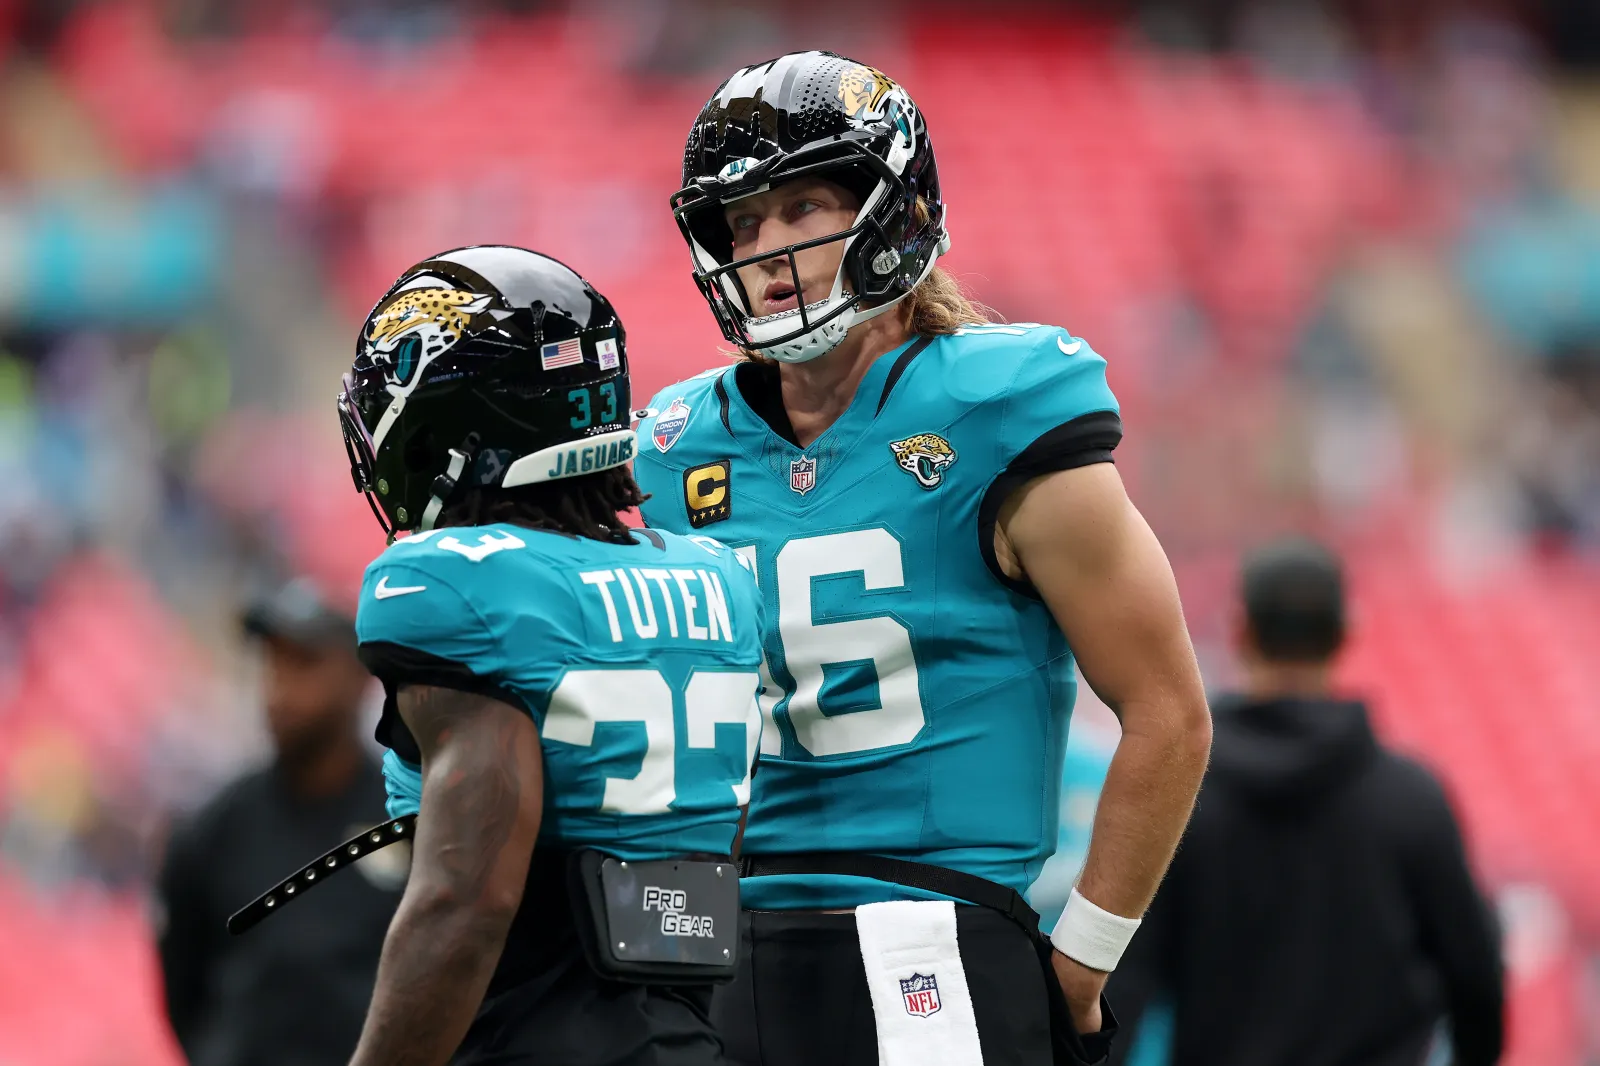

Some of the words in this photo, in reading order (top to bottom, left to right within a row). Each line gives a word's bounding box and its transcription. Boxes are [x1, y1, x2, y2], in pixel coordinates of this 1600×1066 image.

[727, 159, 748, 177] JAX
[568, 382, 616, 429] 33
[656, 419, 684, 431] LONDON
[548, 436, 634, 477] JAGUARS
[686, 465, 726, 511] C
[793, 472, 812, 489] NFL
[578, 567, 733, 643] TUTEN
[643, 886, 687, 912] PRO
[661, 911, 715, 938] GEAR
[906, 991, 938, 1013] NFL
